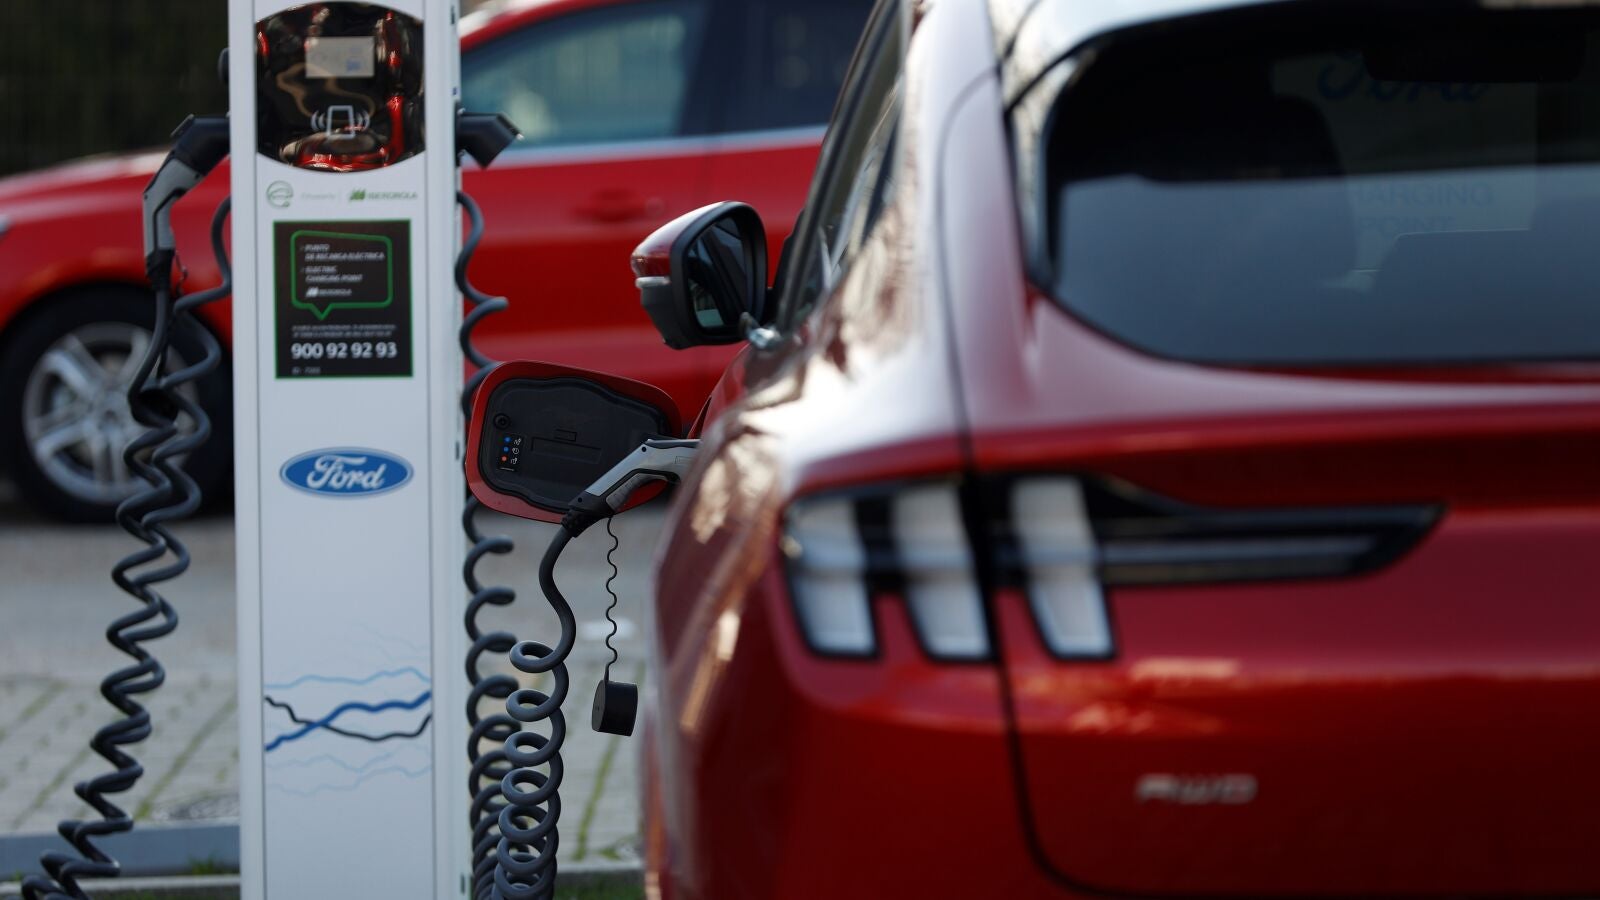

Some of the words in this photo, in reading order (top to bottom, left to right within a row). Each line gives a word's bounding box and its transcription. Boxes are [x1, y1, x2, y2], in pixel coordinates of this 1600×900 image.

[1350, 182, 1496, 208] HARGING
[291, 342, 324, 359] 900
[326, 342, 348, 359] 92
[351, 342, 372, 358] 92
[375, 342, 397, 358] 93
[306, 454, 387, 489] Ford
